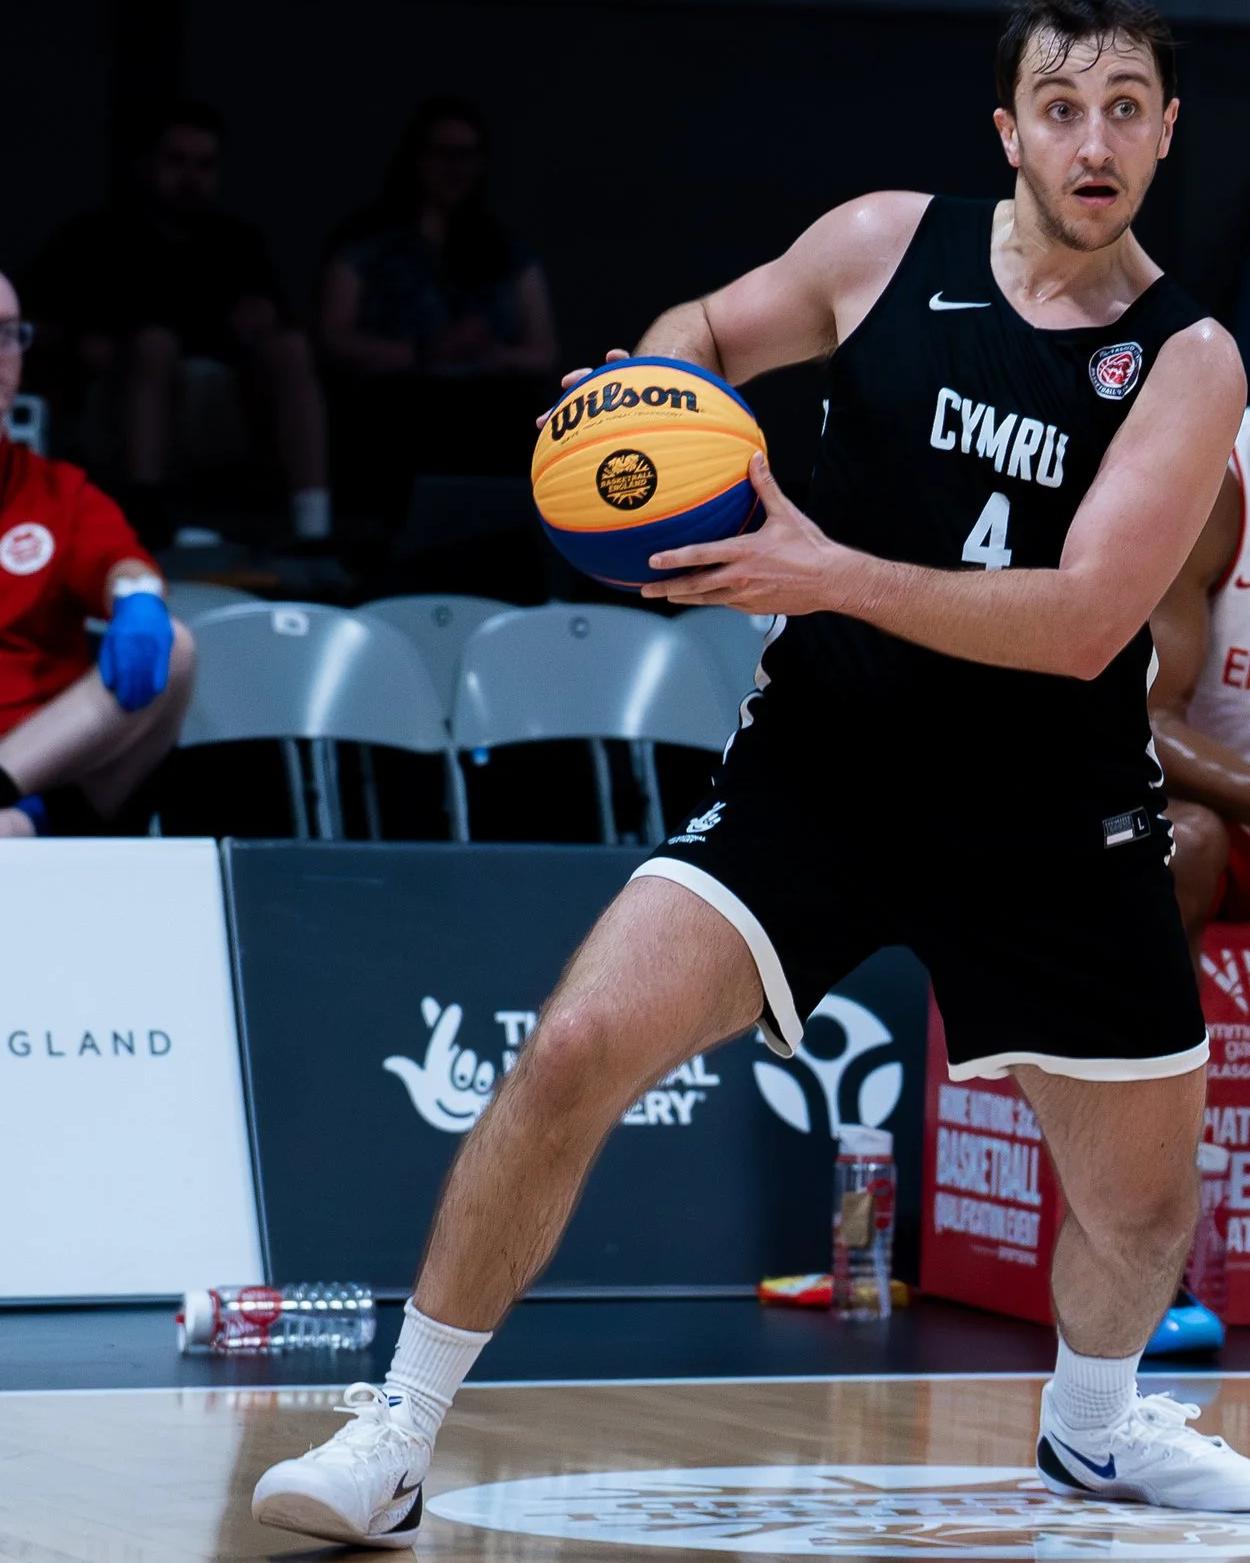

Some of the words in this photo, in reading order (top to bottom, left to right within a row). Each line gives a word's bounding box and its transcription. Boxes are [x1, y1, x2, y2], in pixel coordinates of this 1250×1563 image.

[550, 381, 700, 441] Wilson
[930, 387, 1070, 489] CYMRU
[961, 491, 1012, 571] 4
[1137, 817, 1145, 831] L
[8, 1030, 172, 1057] GLAND
